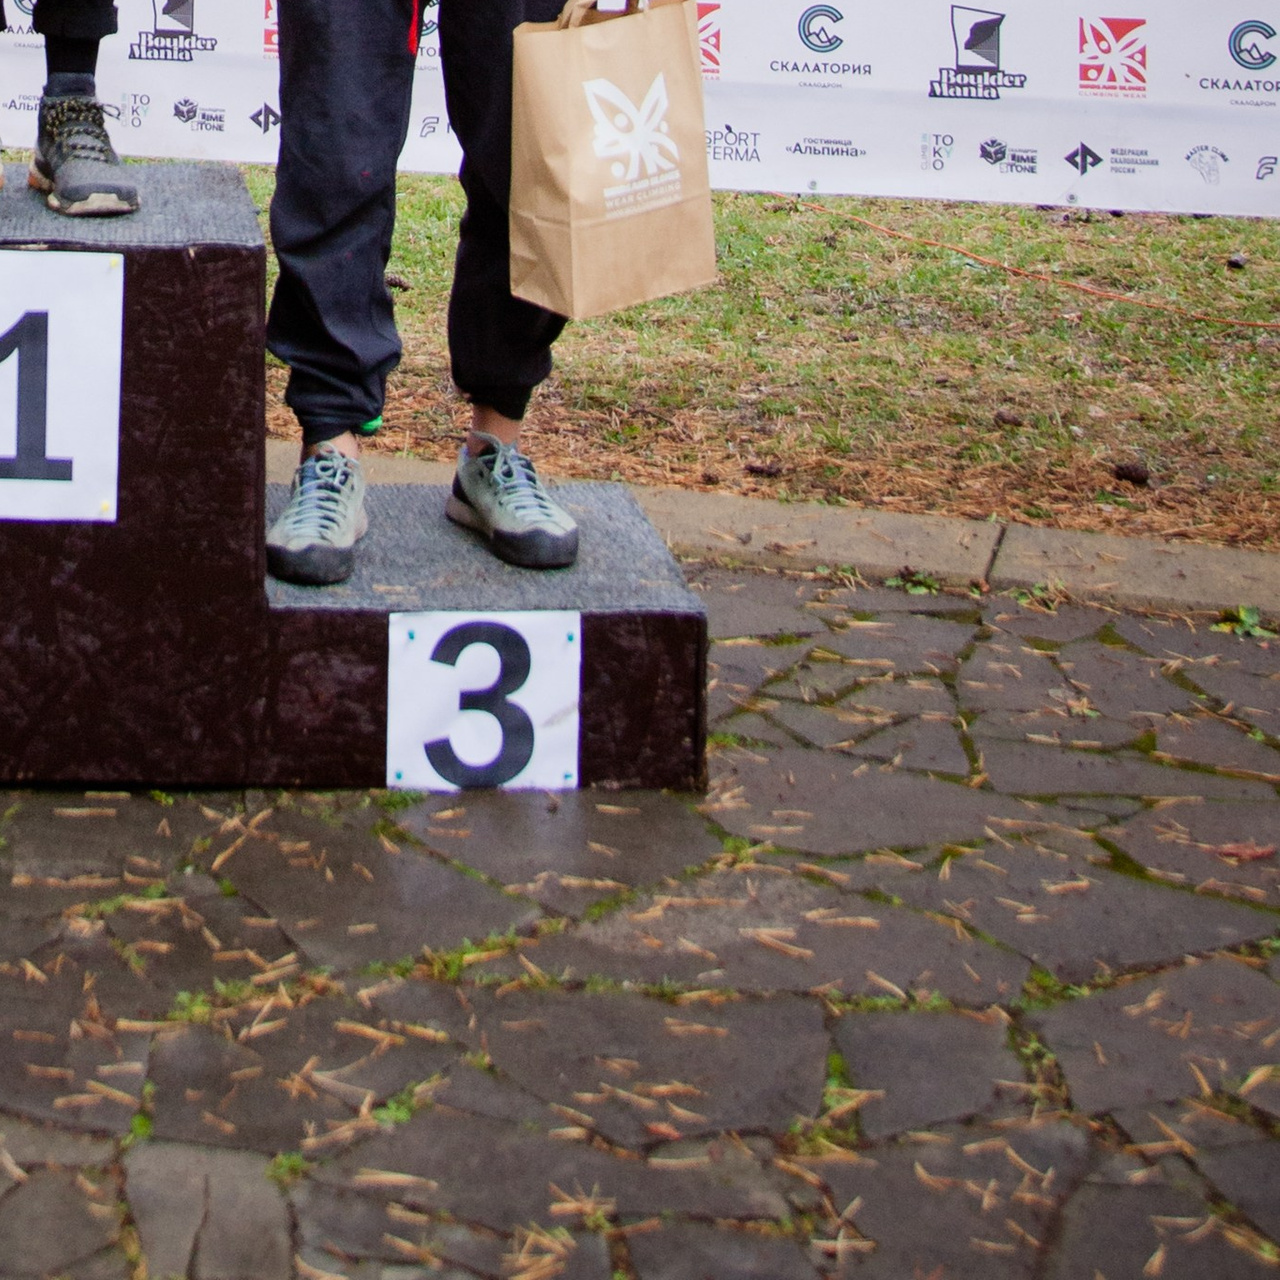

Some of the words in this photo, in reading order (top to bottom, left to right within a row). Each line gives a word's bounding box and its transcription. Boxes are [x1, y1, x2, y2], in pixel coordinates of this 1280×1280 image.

[139, 32, 217, 50] Boulder
[129, 44, 193, 61] Mania
[770, 61, 871, 75] СКАЛАТОРИЯ
[939, 68, 1027, 88] Boulder
[928, 80, 1000, 99] Mania
[804, 138, 852, 146] гостиница
[424, 621, 535, 787] 3
